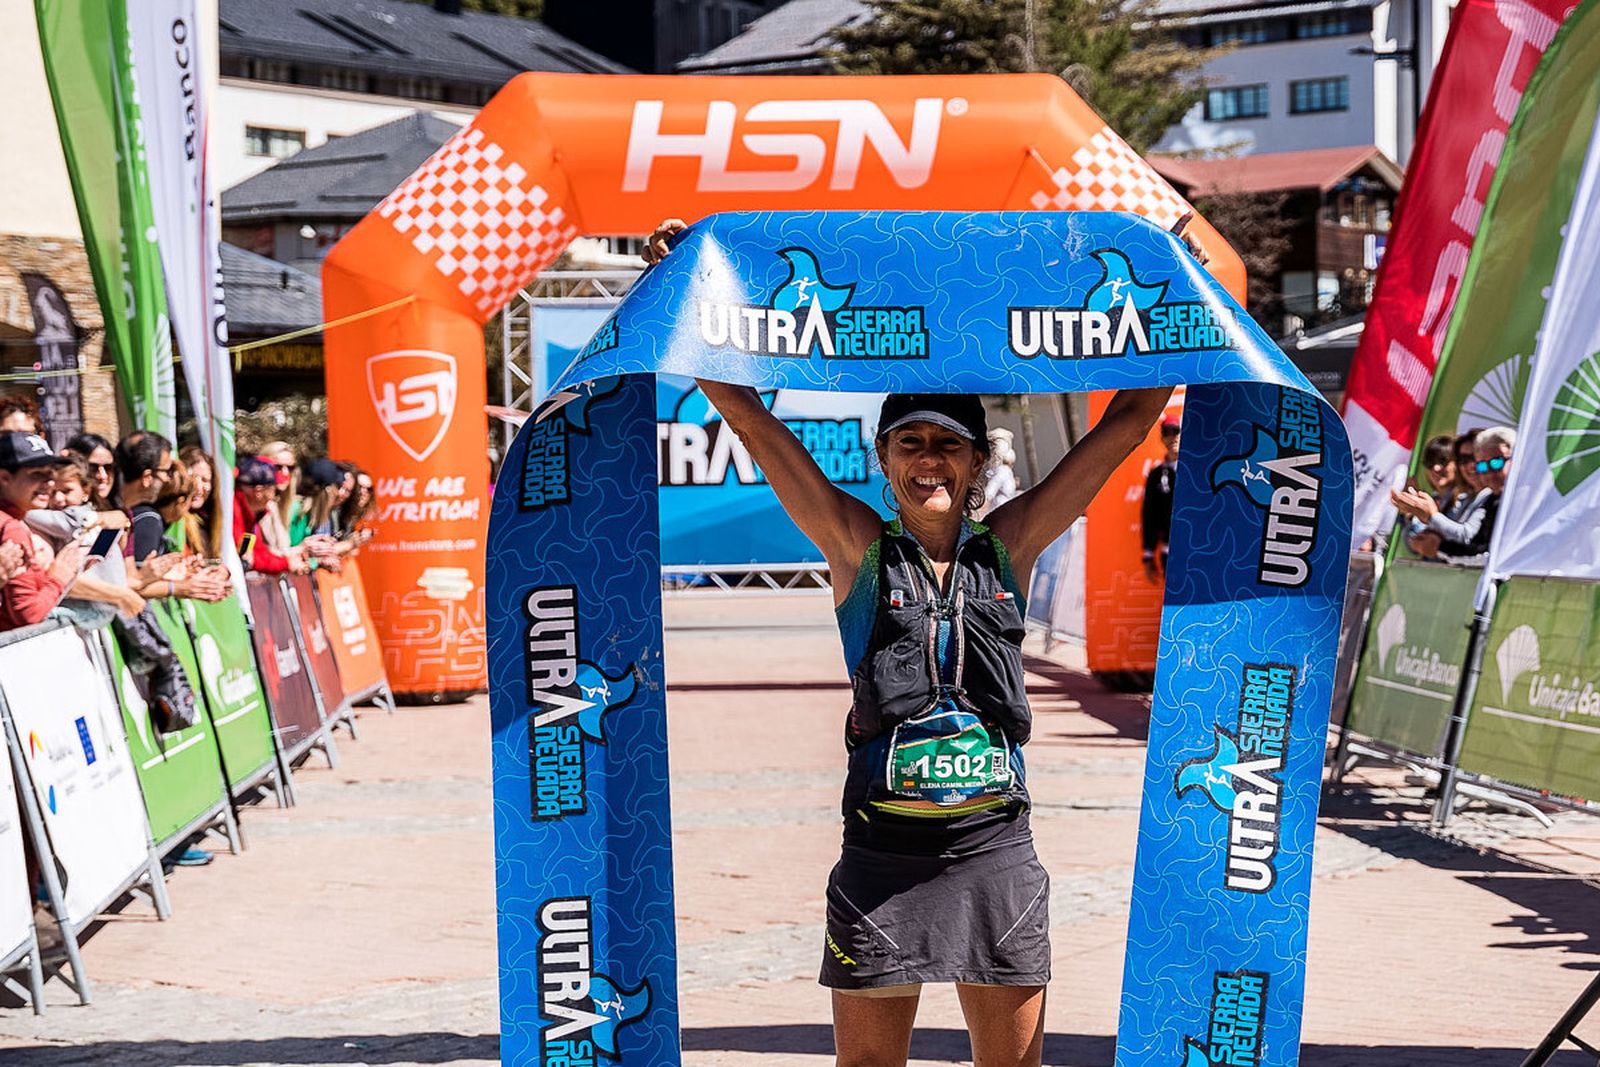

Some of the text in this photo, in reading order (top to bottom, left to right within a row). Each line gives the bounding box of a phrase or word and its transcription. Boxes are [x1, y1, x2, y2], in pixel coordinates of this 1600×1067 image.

[622, 98, 944, 192] HSN
[699, 292, 835, 356] ULTRA
[835, 310, 921, 334] SIERRA
[835, 333, 926, 357] NEVADA
[1011, 291, 1150, 356] ULTRA
[377, 476, 466, 497] WE ARE
[523, 420, 548, 507] NEVADA
[545, 417, 567, 500] SIERRA
[657, 415, 757, 486] TRA
[1257, 452, 1321, 586] ULTRA
[527, 588, 597, 728] ULTRA
[1240, 669, 1269, 752] SIERRA
[1261, 667, 1292, 757] NEVADA
[534, 727, 561, 817] NEVADA
[557, 725, 583, 812] SIERRA
[916, 755, 987, 779] 1502
[1219, 757, 1281, 891] ULTRA
[541, 899, 611, 1041] ULTRA
[1210, 977, 1240, 1064] SIERRA
[1231, 975, 1263, 1067] NEVADA
